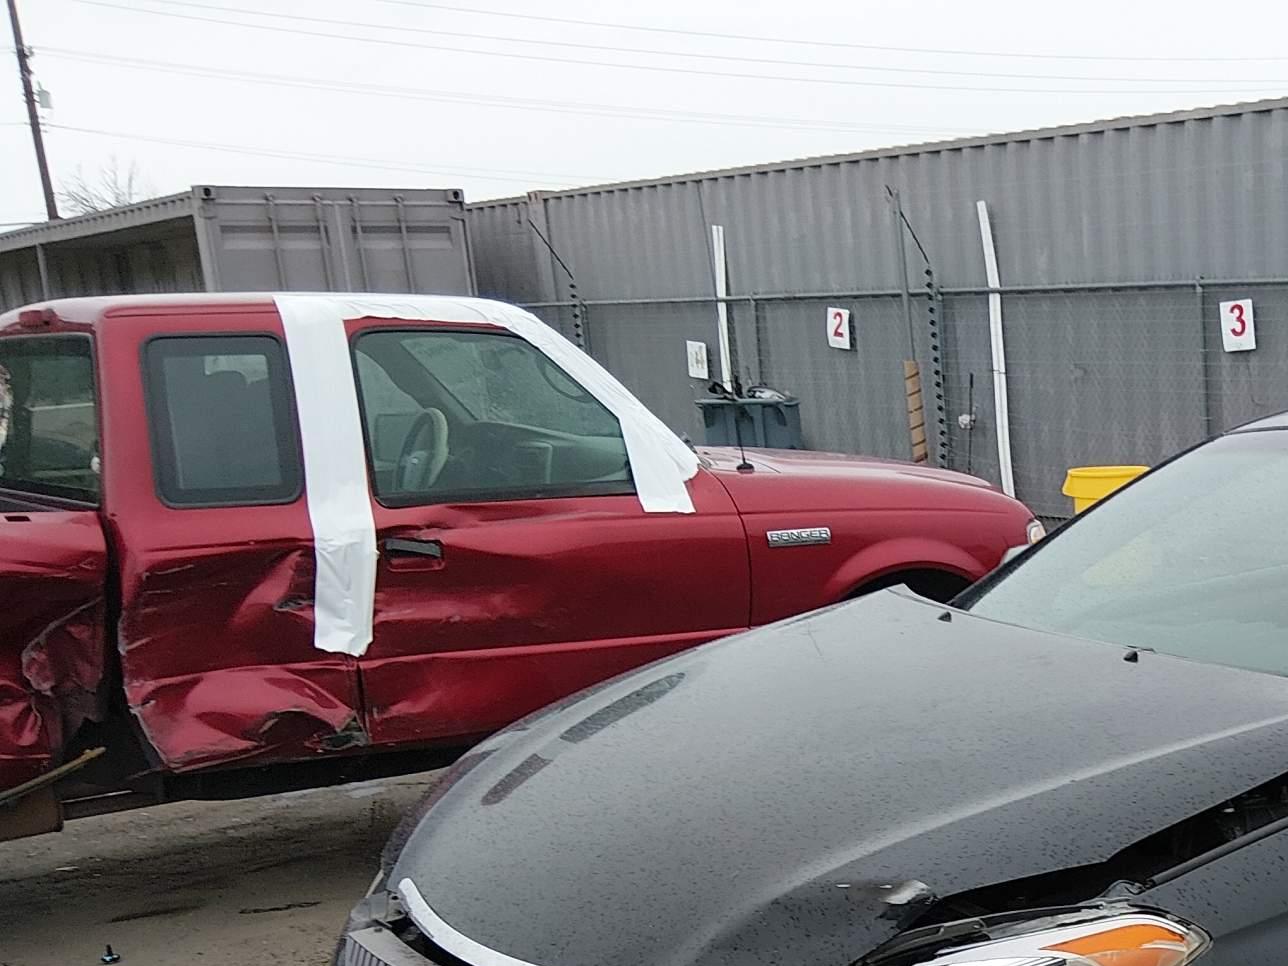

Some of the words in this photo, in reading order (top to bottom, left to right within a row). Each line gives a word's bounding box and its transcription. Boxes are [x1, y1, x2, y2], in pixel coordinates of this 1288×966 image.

[833, 312, 844, 338] 2
[1229, 304, 1246, 337] 3
[769, 530, 829, 542] RANGER
